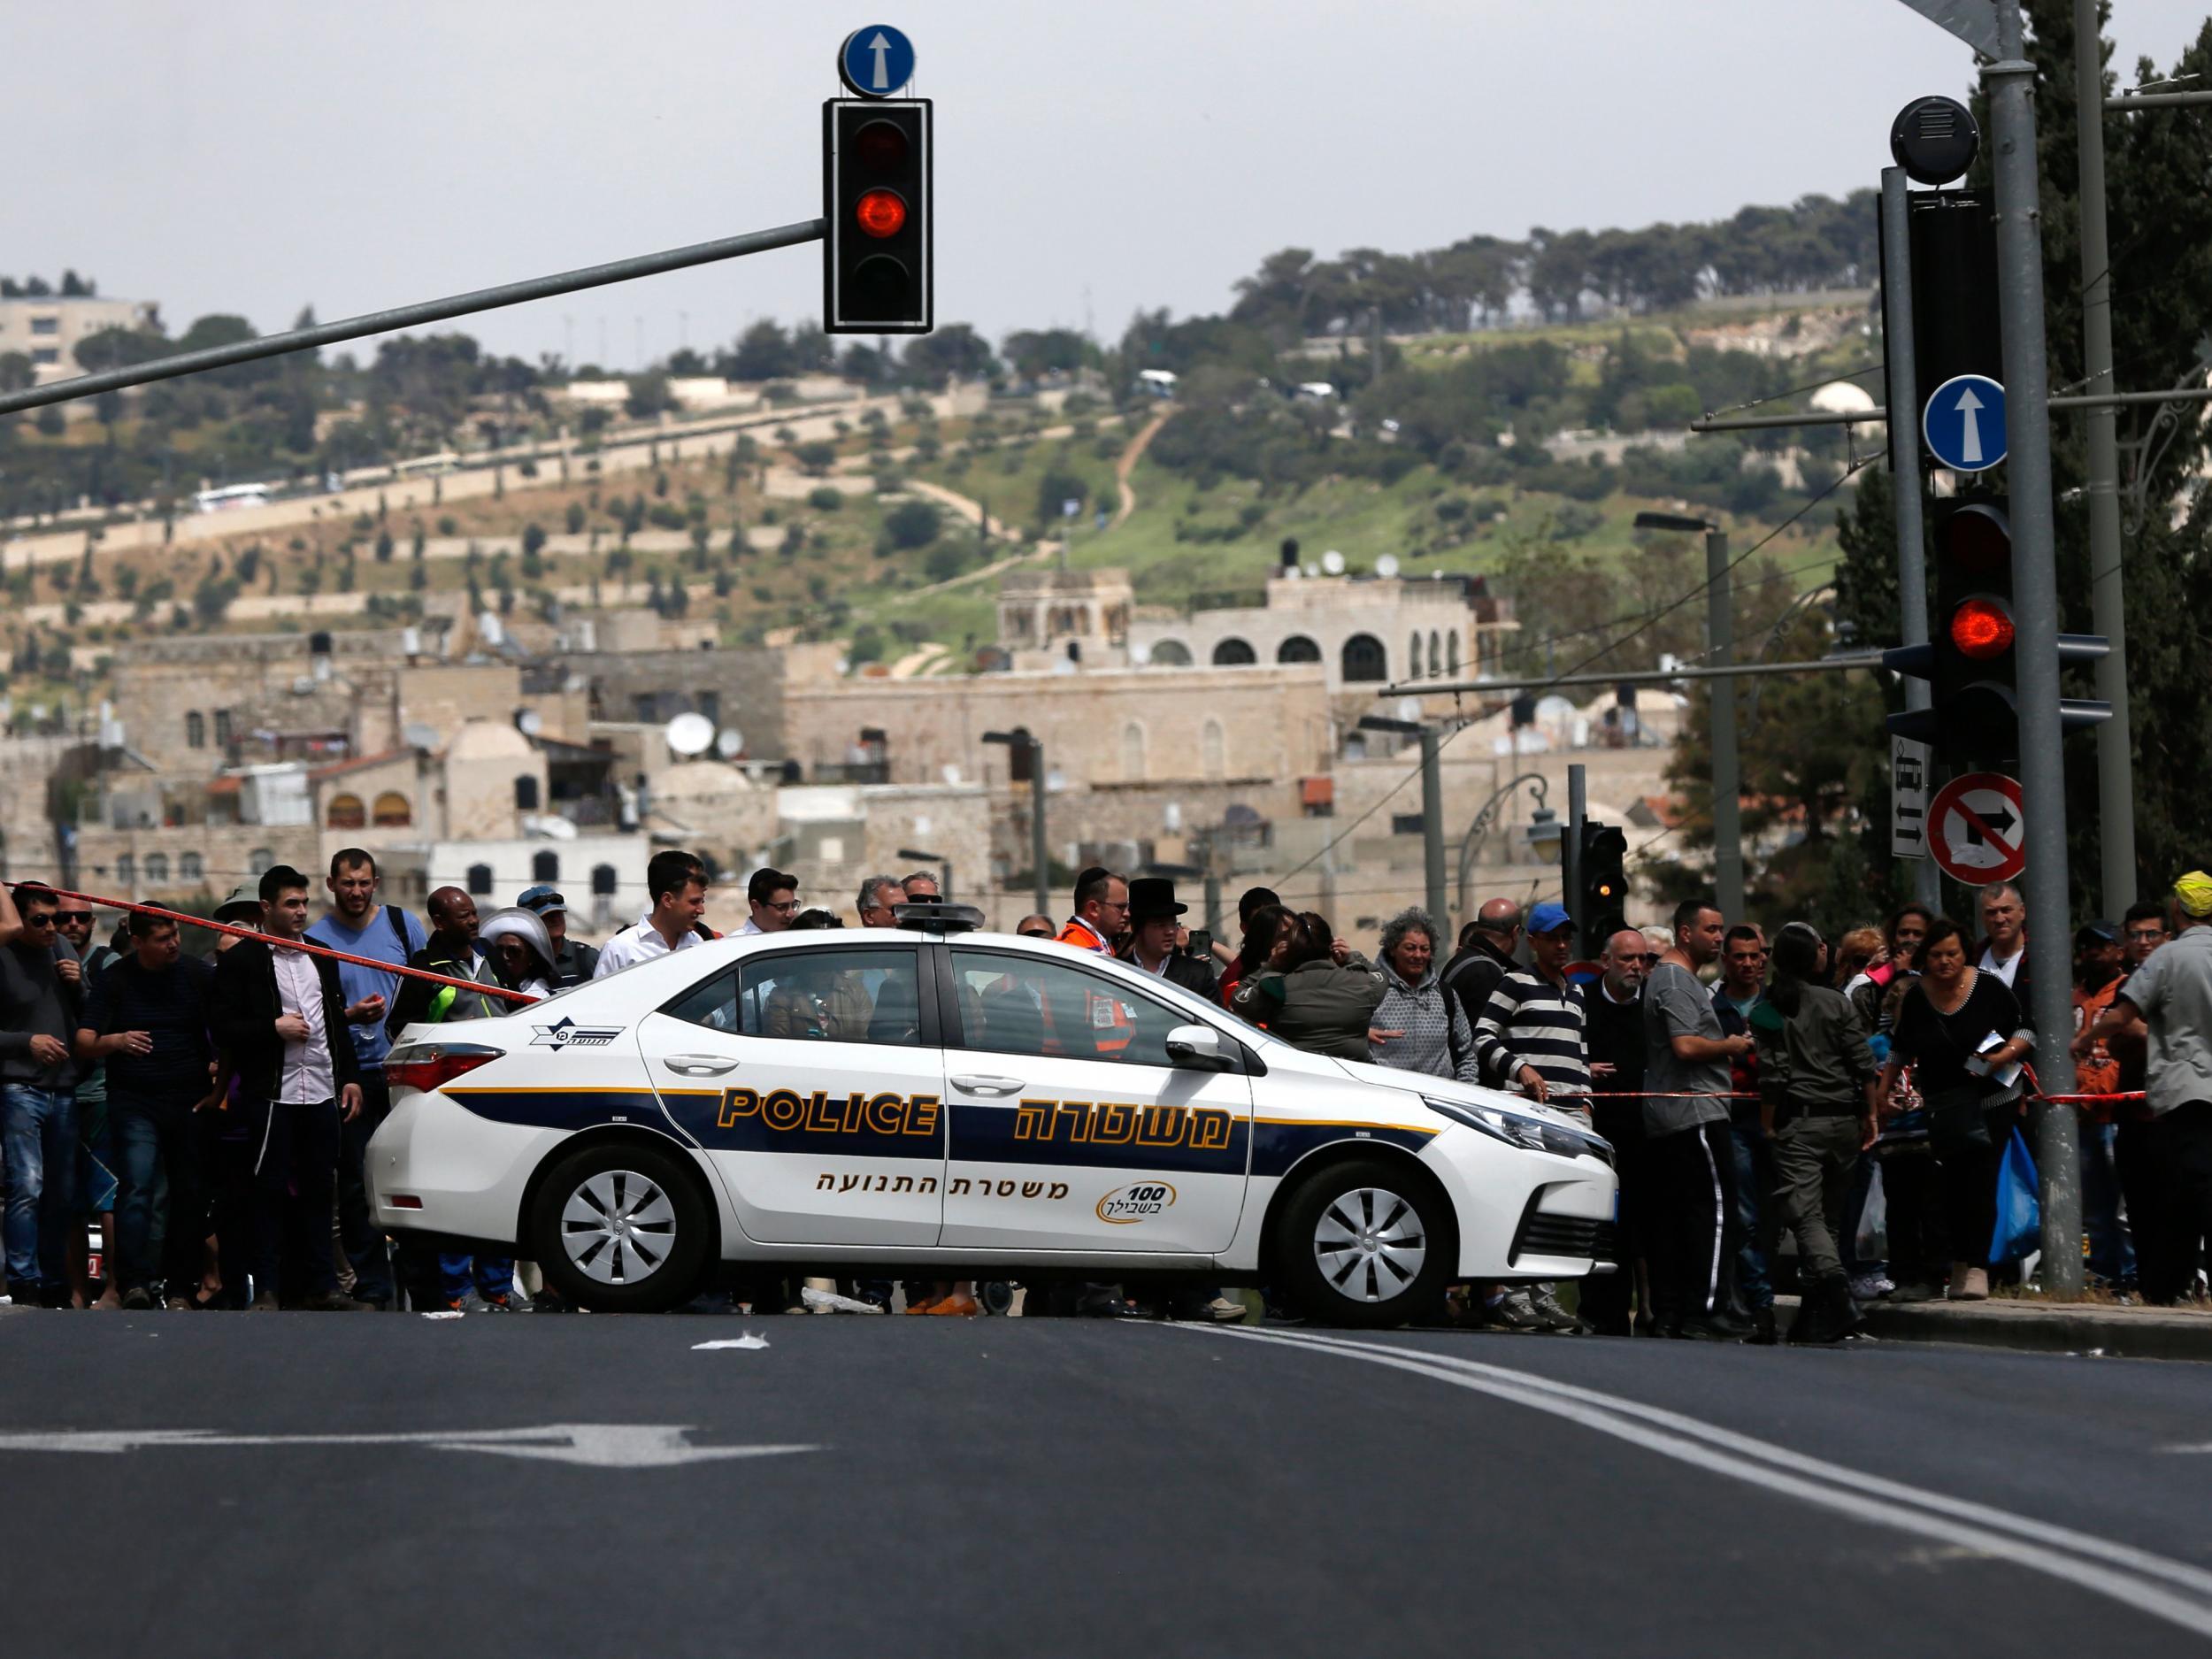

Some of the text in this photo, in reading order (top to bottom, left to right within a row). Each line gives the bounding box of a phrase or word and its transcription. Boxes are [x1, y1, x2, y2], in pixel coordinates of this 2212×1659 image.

[718, 1087, 941, 1136] POLICE
[1014, 1098, 1233, 1149] משטרה
[816, 1172, 1070, 1200] משטרת התנועה
[1128, 1187, 1167, 1202] 100
[1107, 1199, 1162, 1216] בשבילך
